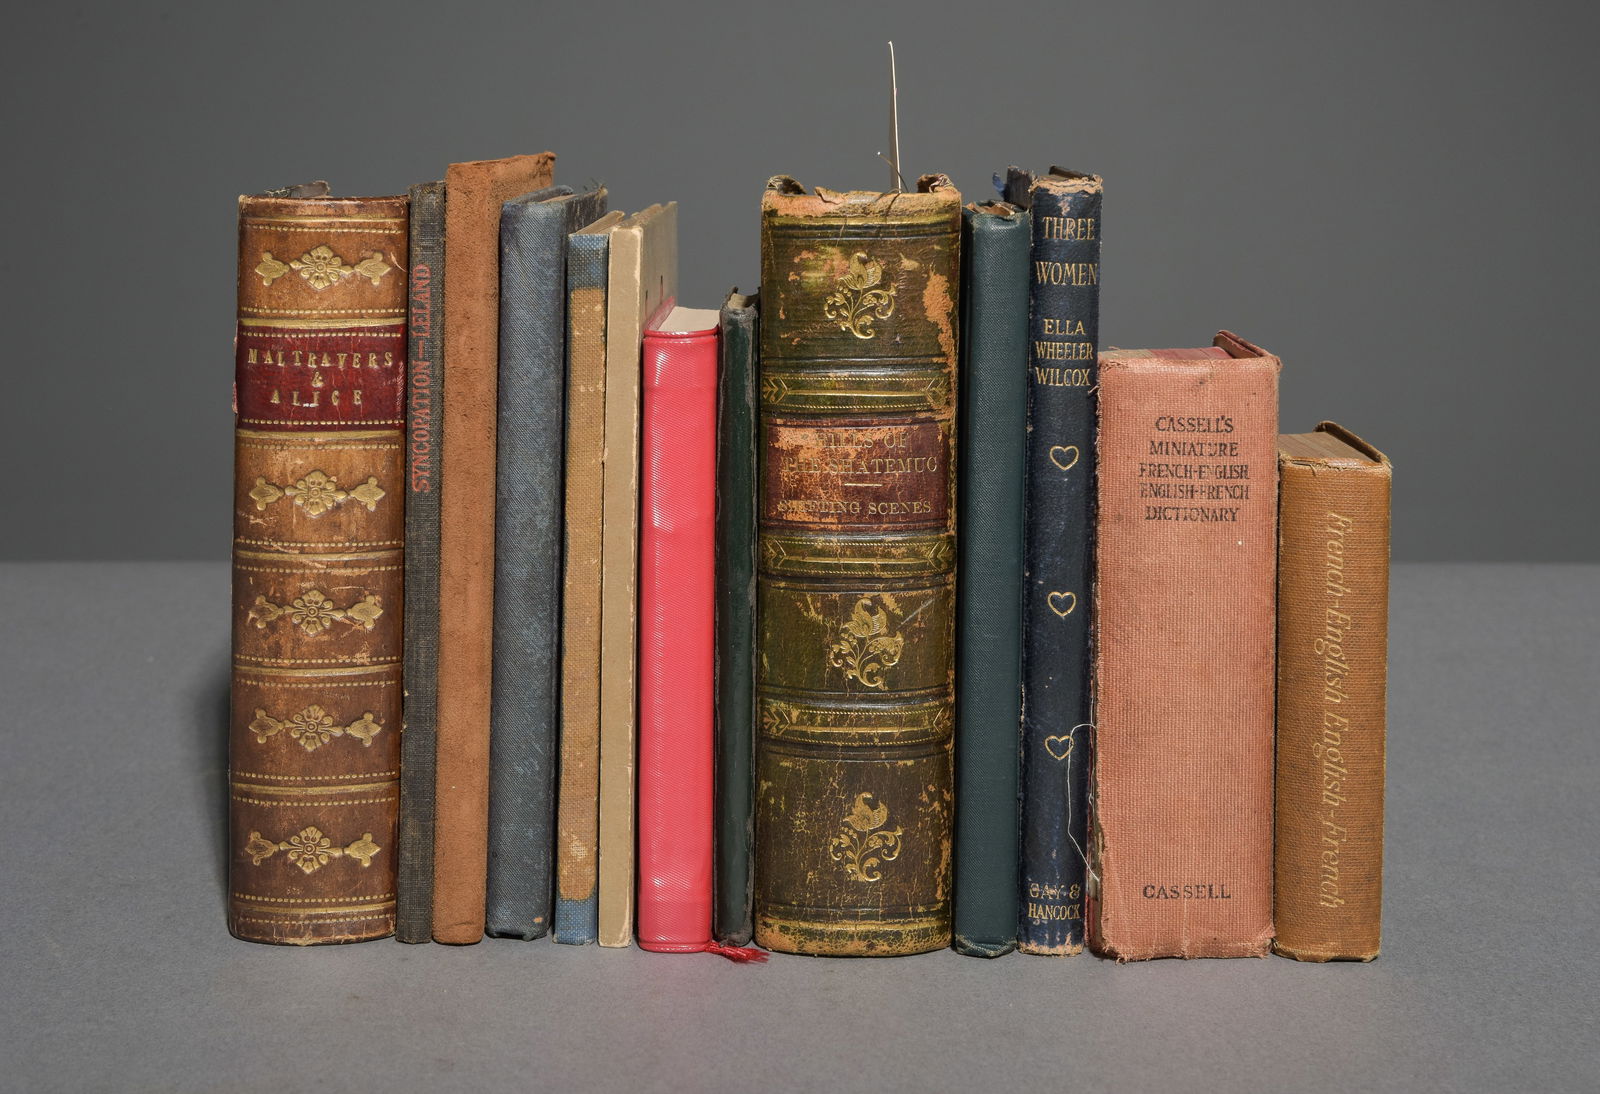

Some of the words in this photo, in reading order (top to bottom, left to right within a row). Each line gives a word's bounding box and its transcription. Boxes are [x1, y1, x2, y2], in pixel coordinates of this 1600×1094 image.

[1042, 216, 1096, 241] THREE
[1035, 261, 1098, 286] WOMEN
[1043, 318, 1086, 336] ELLA
[247, 348, 393, 369] MALTRAVERS
[1035, 341, 1094, 360] WHEELER
[311, 371, 325, 388] &
[1035, 367, 1092, 387] WILCOX
[270, 389, 363, 408] ALICE
[1155, 415, 1234, 433] CASSELL'S
[883, 431, 909, 448] OF
[1149, 440, 1239, 457] MINIATURE
[781, 456, 822, 473] THE
[829, 456, 938, 475] SHATEMUC
[1138, 463, 1250, 480] FRENCH-ENGLISH
[1138, 482, 1250, 500] ENGLISH-FRENCH
[868, 501, 932, 515] SCENES
[1144, 506, 1240, 522] DICTIONARY
[1314, 510, 1353, 704] French-English
[1312, 711, 1350, 909] English-French
[1069, 882, 1080, 900] &
[1142, 884, 1232, 899] CASSELL
[1027, 902, 1081, 921] HANCOCK
